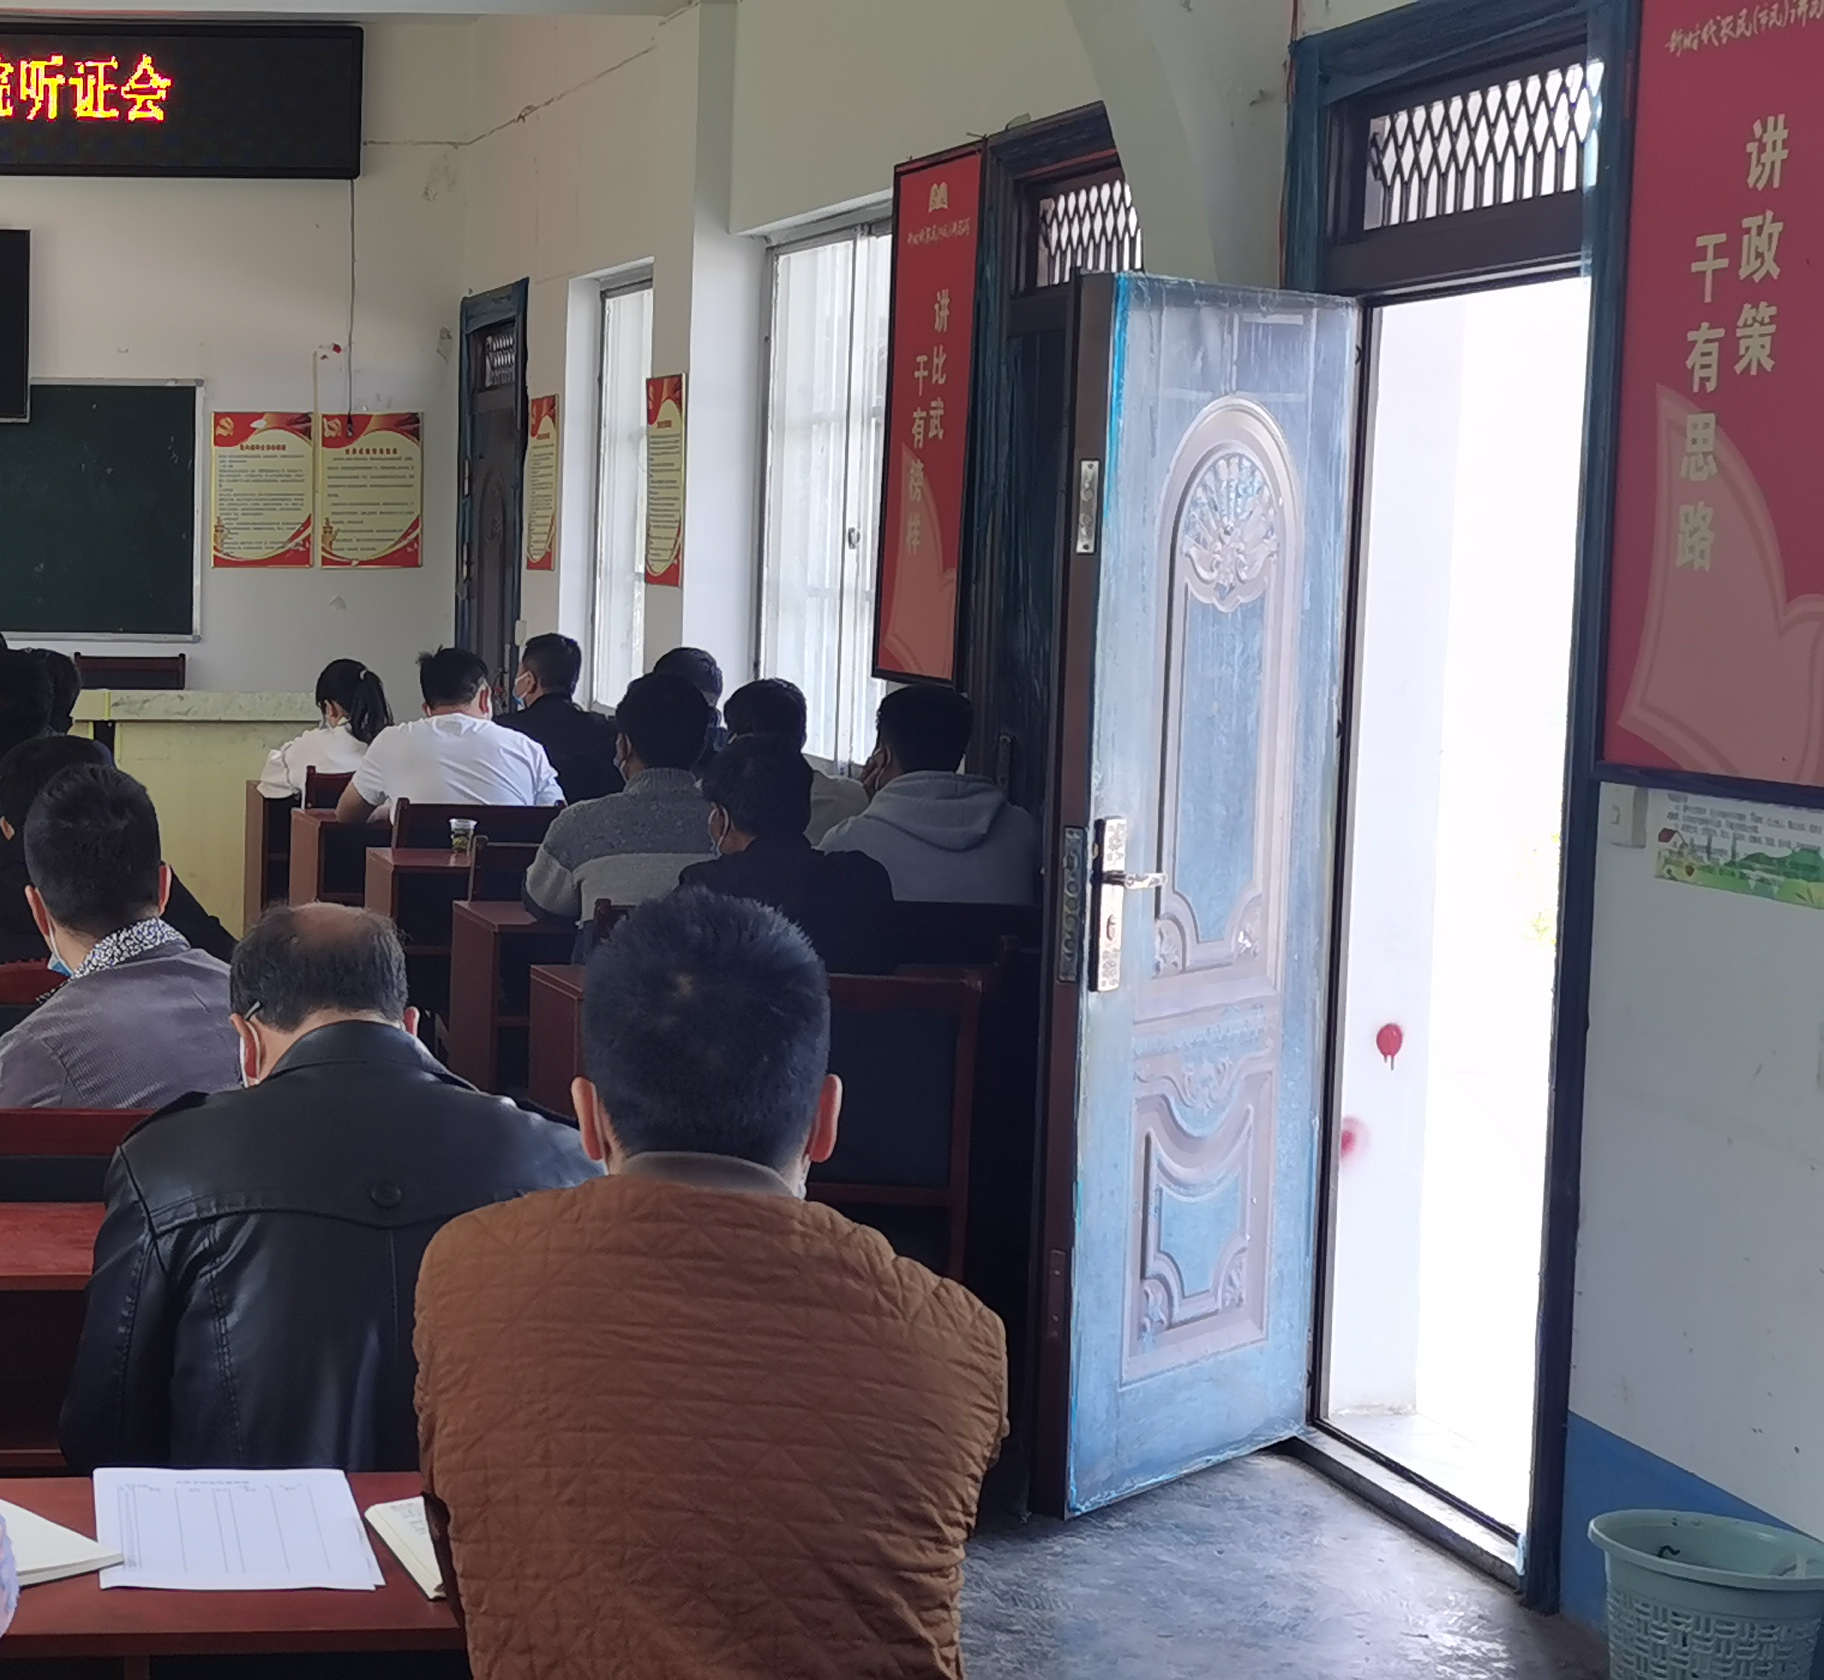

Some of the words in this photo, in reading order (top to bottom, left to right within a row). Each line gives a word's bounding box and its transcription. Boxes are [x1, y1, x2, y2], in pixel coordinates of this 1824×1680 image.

[1734, 113, 1789, 377] 讲政策
[906, 355, 930, 556] 干有榜样
[929, 289, 951, 441] 讲比武
[1675, 233, 1729, 573] 干有思路
